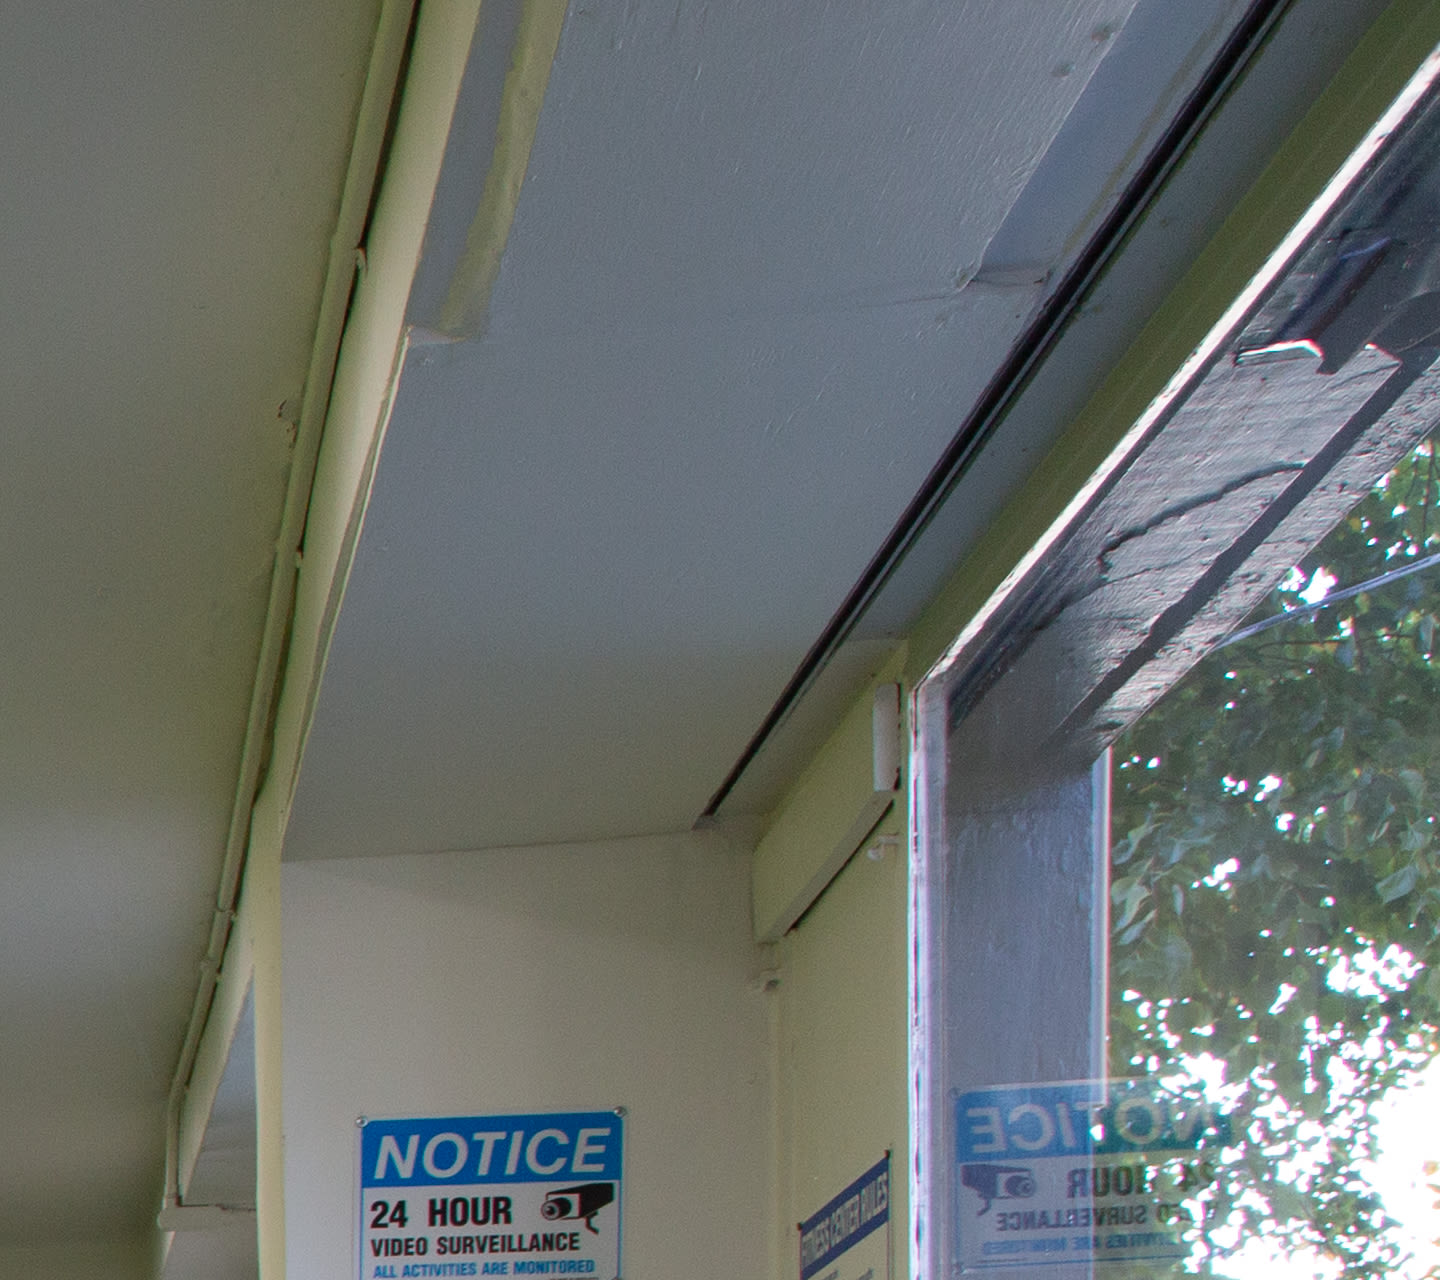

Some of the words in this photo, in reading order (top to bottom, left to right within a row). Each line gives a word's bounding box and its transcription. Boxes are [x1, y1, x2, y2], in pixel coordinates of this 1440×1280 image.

[374, 1127, 611, 1180] NOTICE
[370, 1200, 408, 1229] 24
[428, 1196, 513, 1227] HOUR
[370, 1236, 428, 1257] VIDEO
[436, 1232, 580, 1255] SURVEILLANCE
[373, 1264, 397, 1279] ALL
[401, 1261, 477, 1278] ACTIVITIES
[481, 1261, 509, 1275] ARE
[513, 1259, 595, 1275] MONITORED
